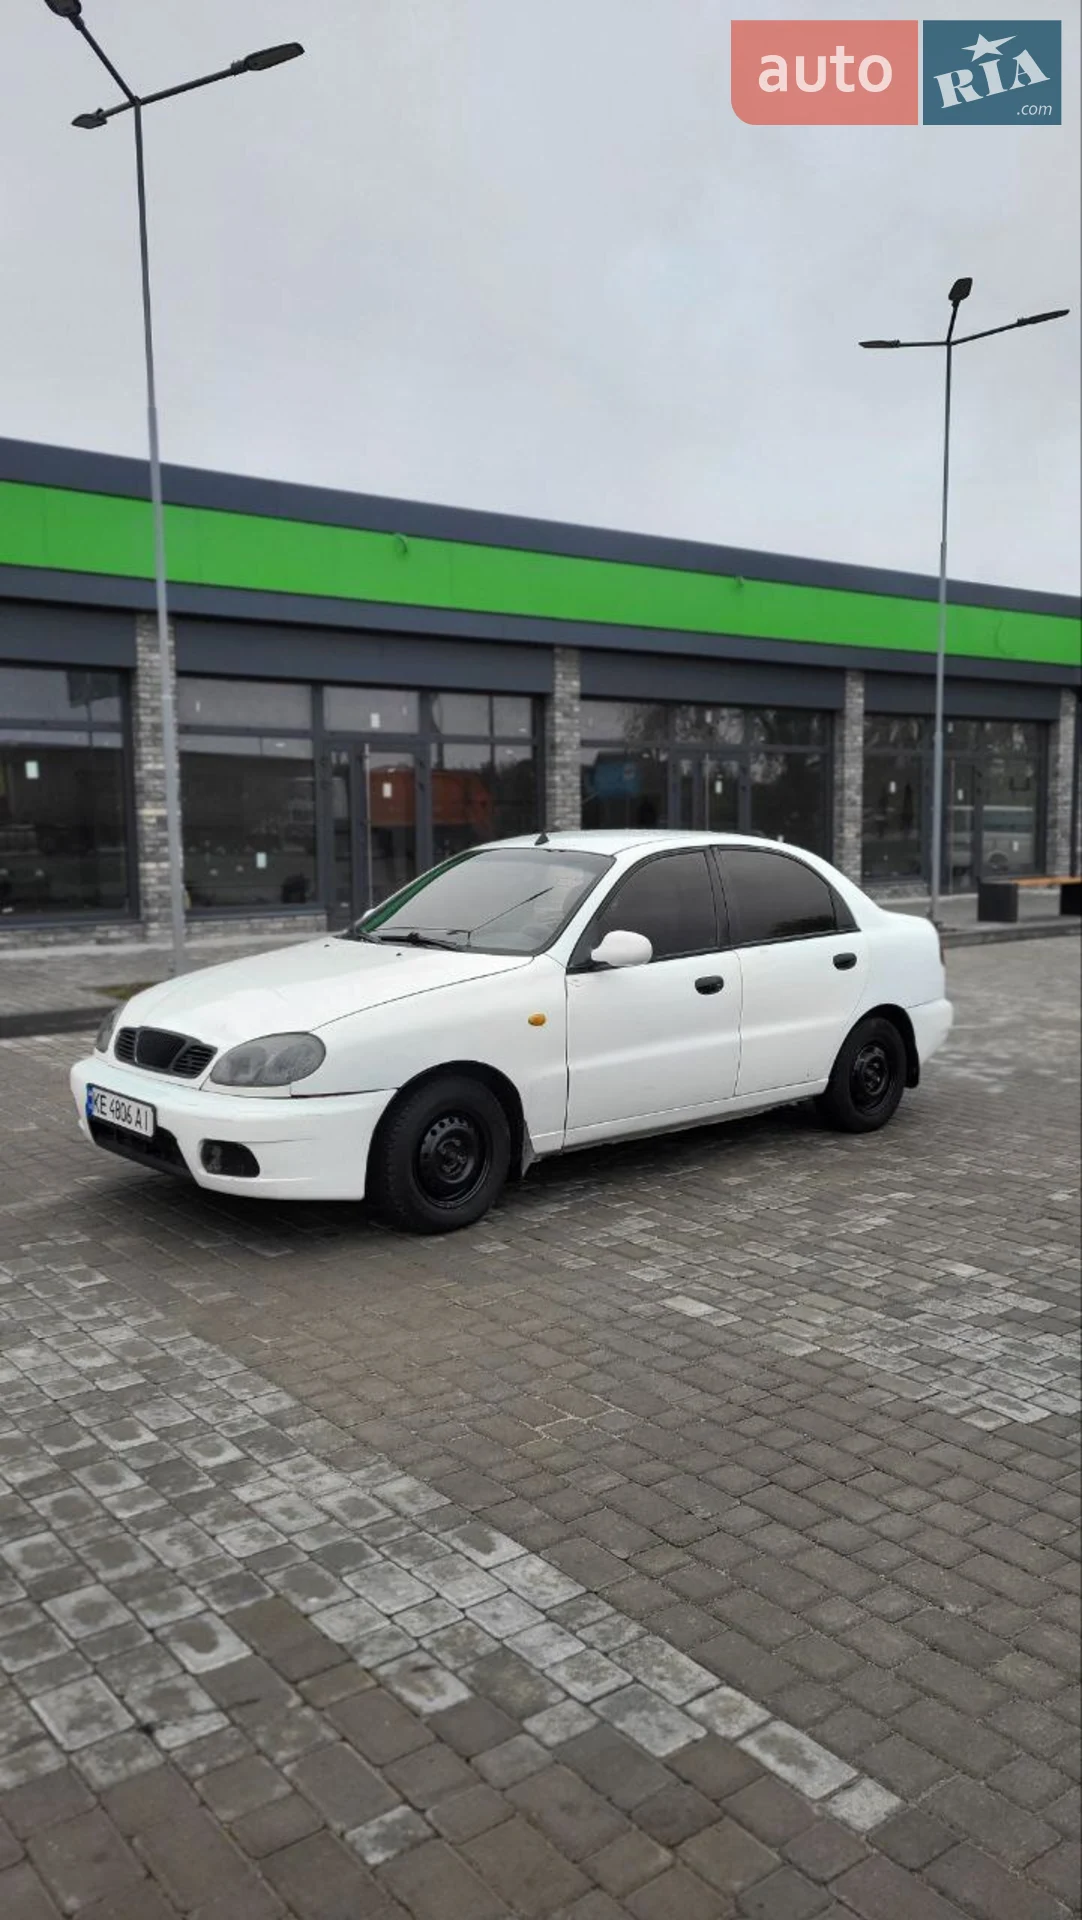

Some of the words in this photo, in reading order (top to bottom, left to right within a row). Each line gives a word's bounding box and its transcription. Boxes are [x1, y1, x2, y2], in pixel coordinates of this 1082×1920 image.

[94, 1092, 107, 1116] KE
[109, 1099, 133, 1125] 4806
[135, 1108, 148, 1132] AI
